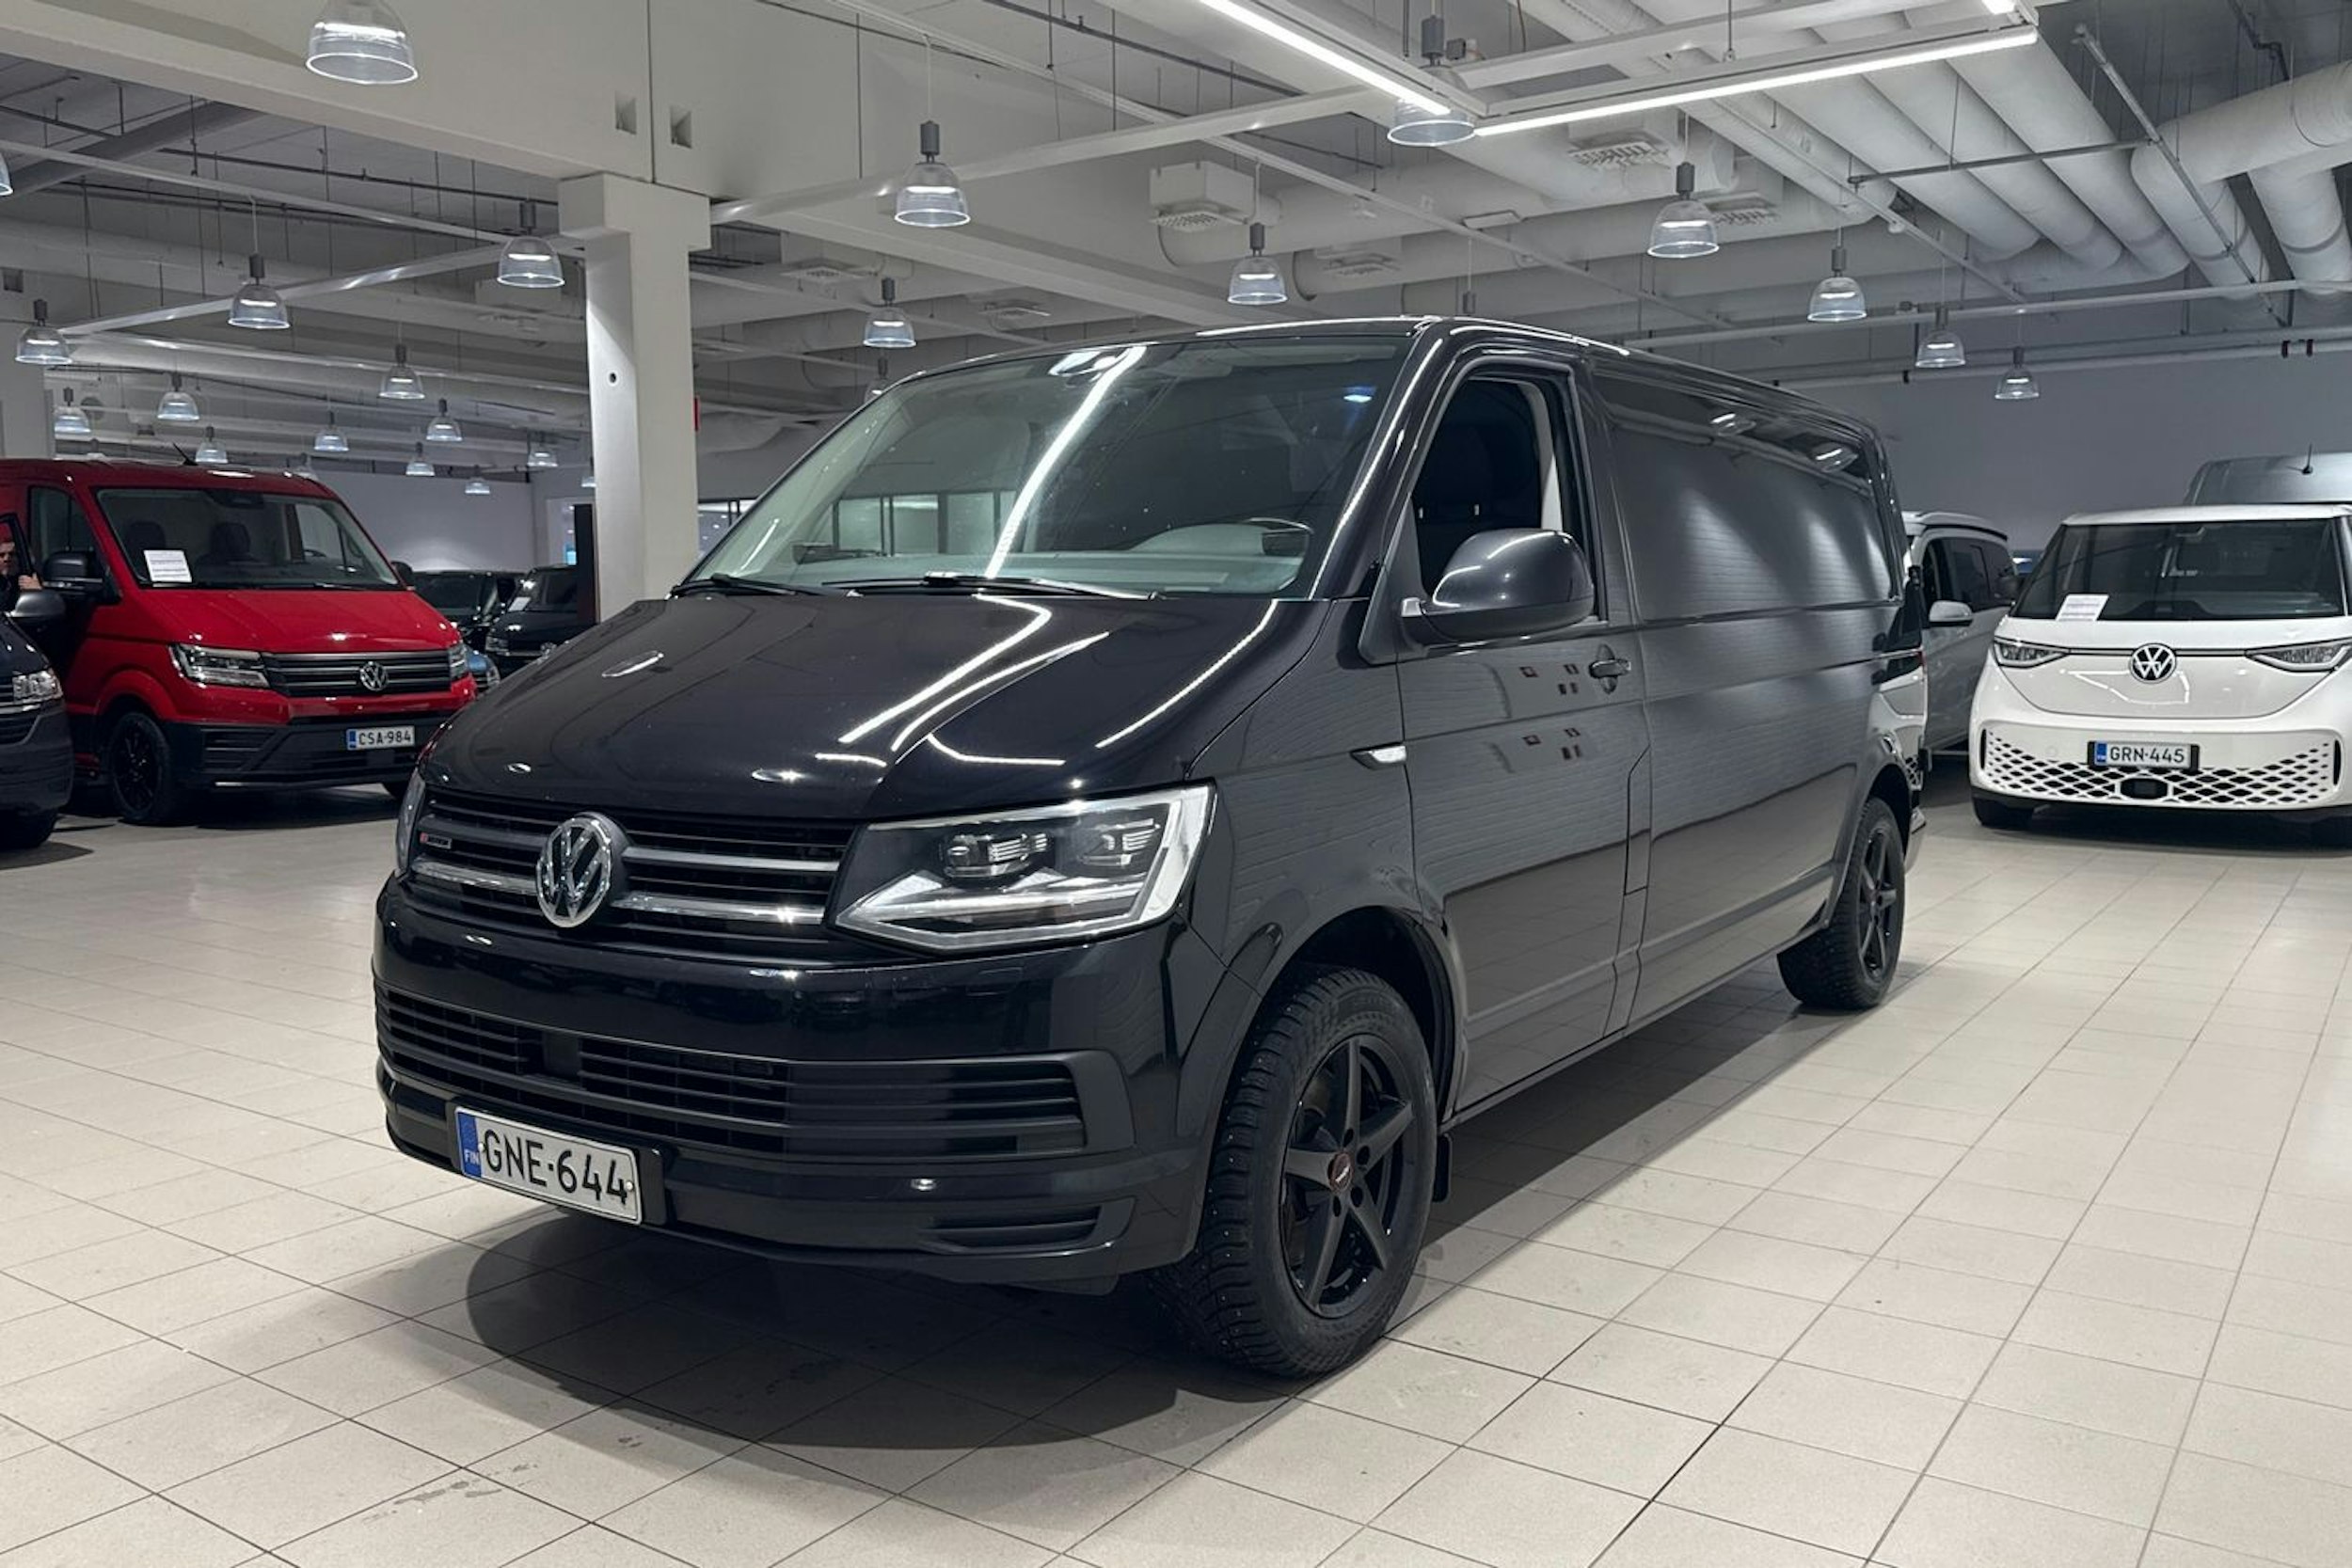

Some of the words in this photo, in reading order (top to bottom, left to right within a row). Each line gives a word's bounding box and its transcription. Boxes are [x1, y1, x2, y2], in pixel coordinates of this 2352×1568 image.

[2130, 642, 2176, 684] VW
[358, 731, 411, 745] CSA-984
[2110, 746, 2185, 763] GRN-445
[536, 817, 611, 927] VW
[465, 1149, 480, 1166] FIN
[485, 1130, 628, 1205] GNE-644
